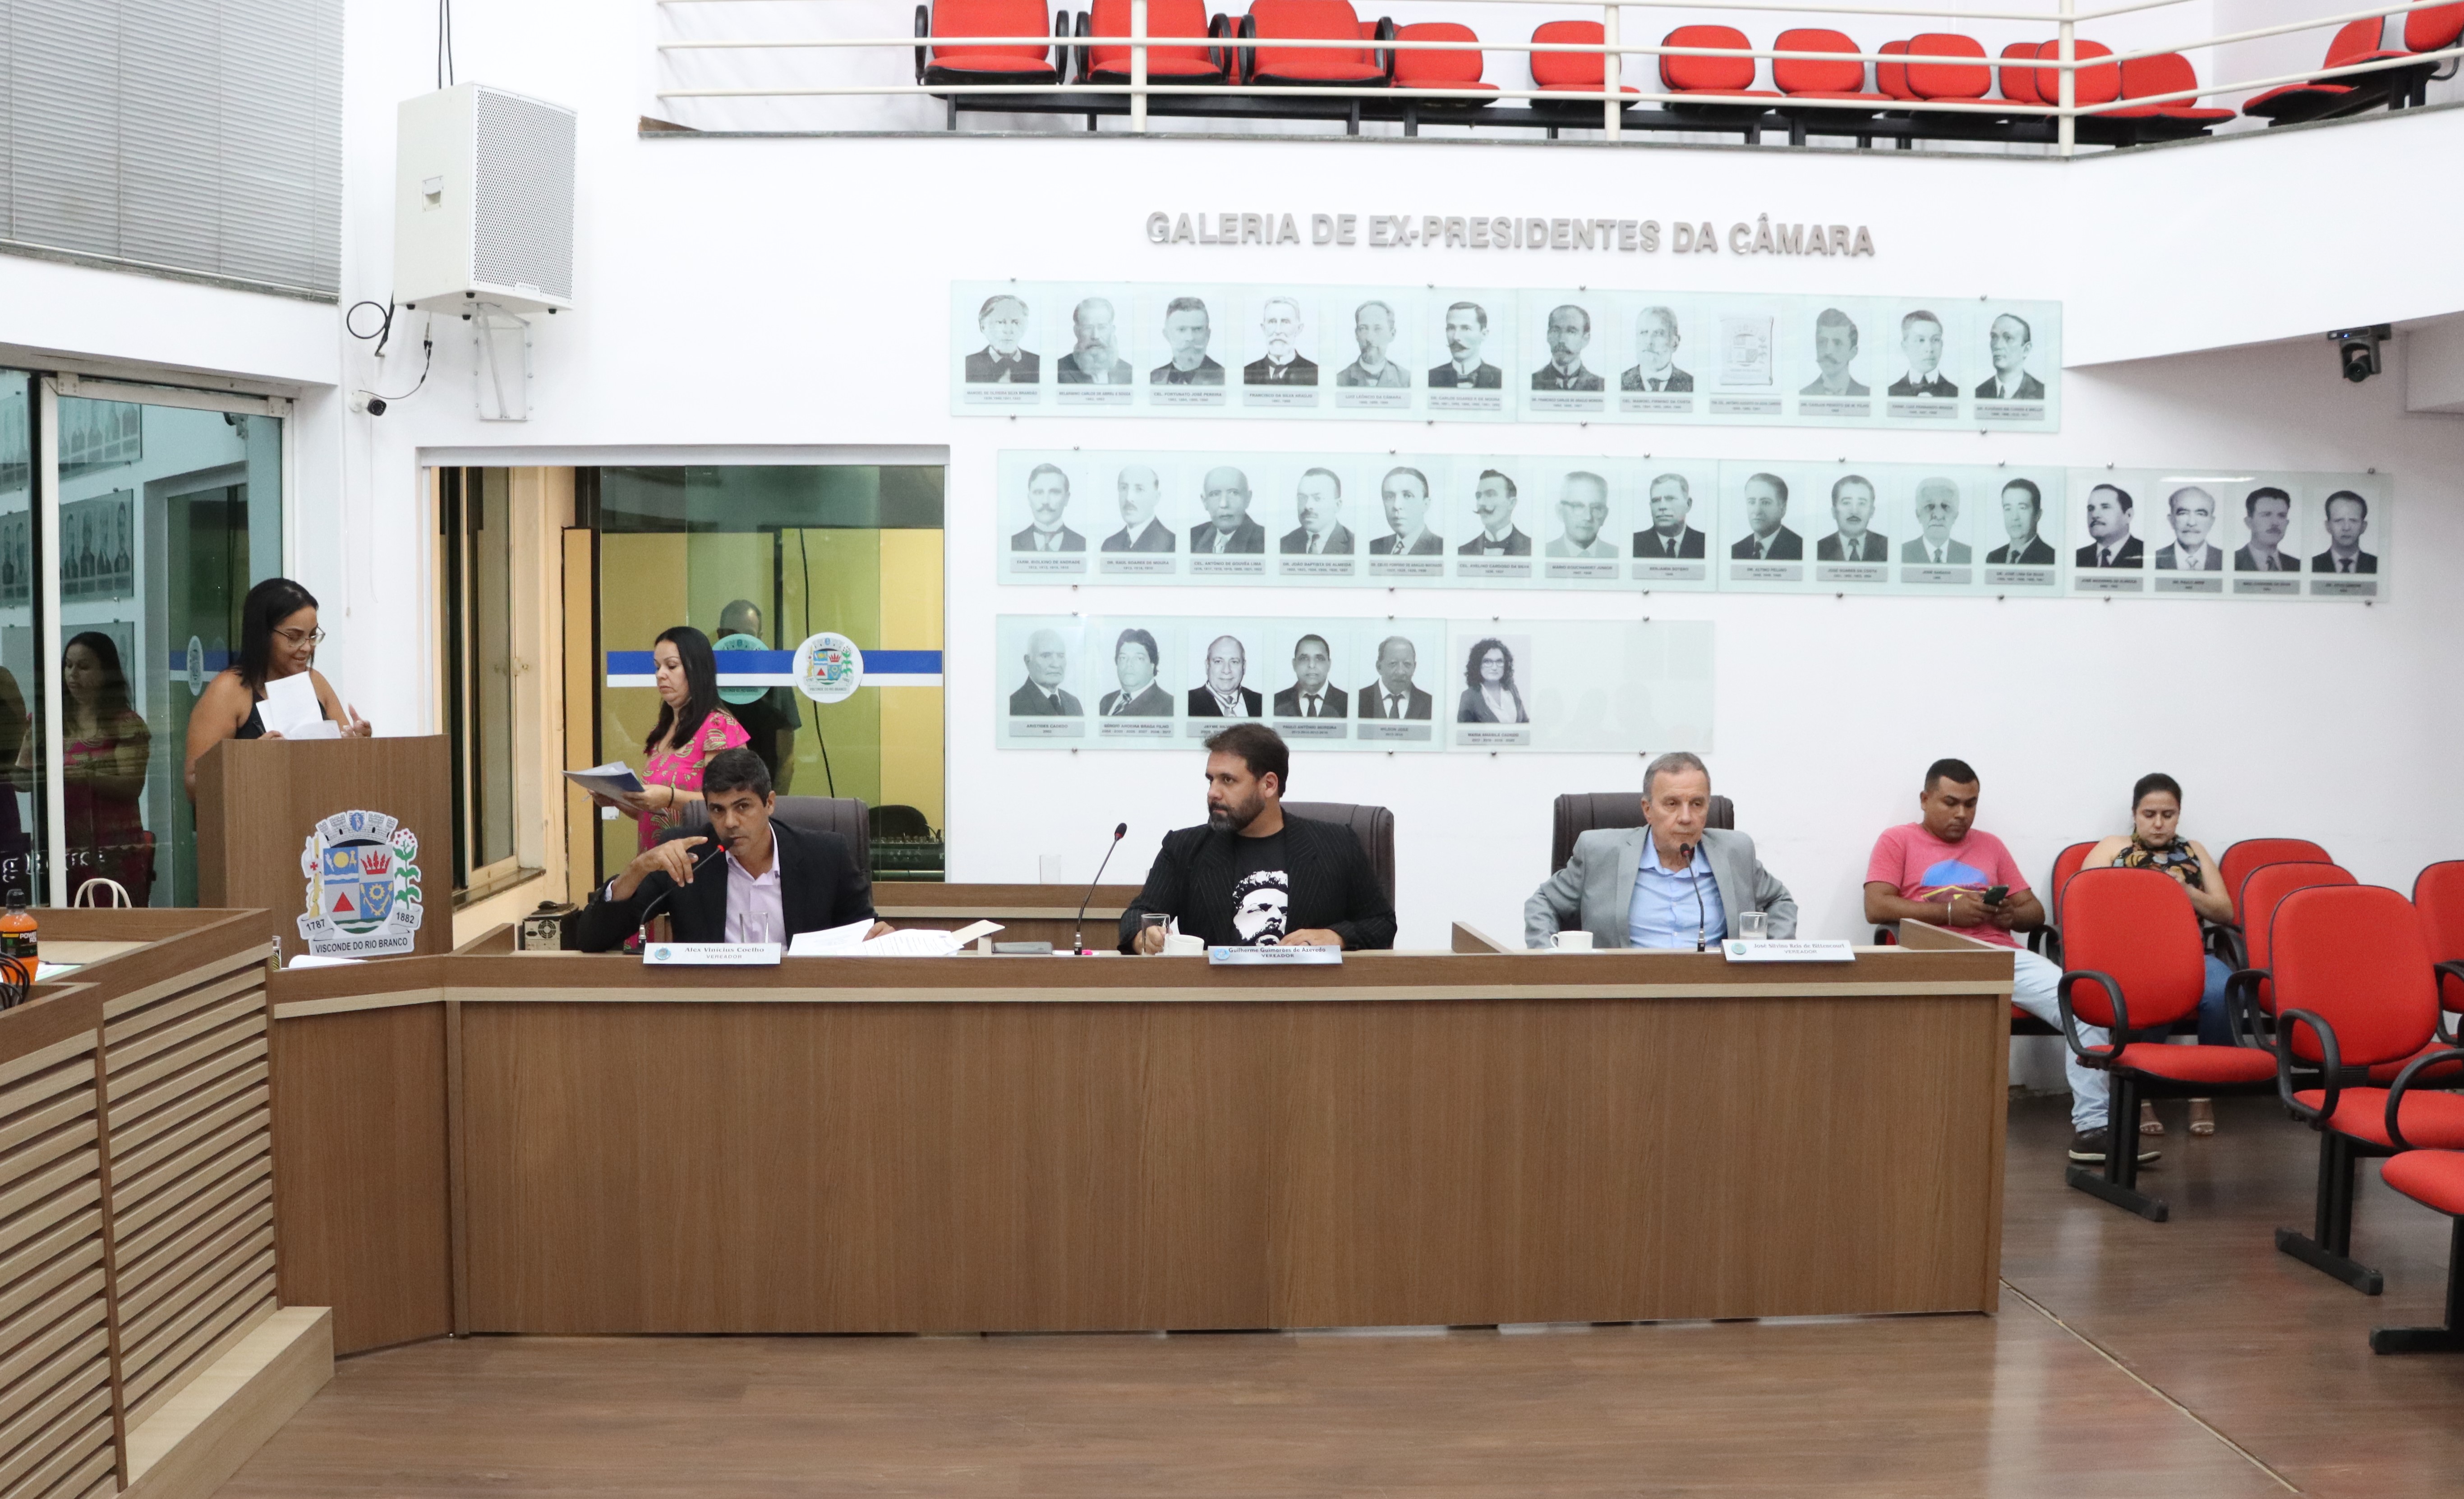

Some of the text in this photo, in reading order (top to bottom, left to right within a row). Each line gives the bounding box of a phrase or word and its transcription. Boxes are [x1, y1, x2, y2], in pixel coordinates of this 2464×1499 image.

[1146, 211, 1875, 257] GALERIA DE EX-PRESIDENTES DA CÂMARA
[396, 912, 414, 924] 1882
[306, 919, 325, 931] 1787
[19, 931, 37, 939] POWE
[316, 938, 407, 953] VISCONDE DO RIO BRANCO
